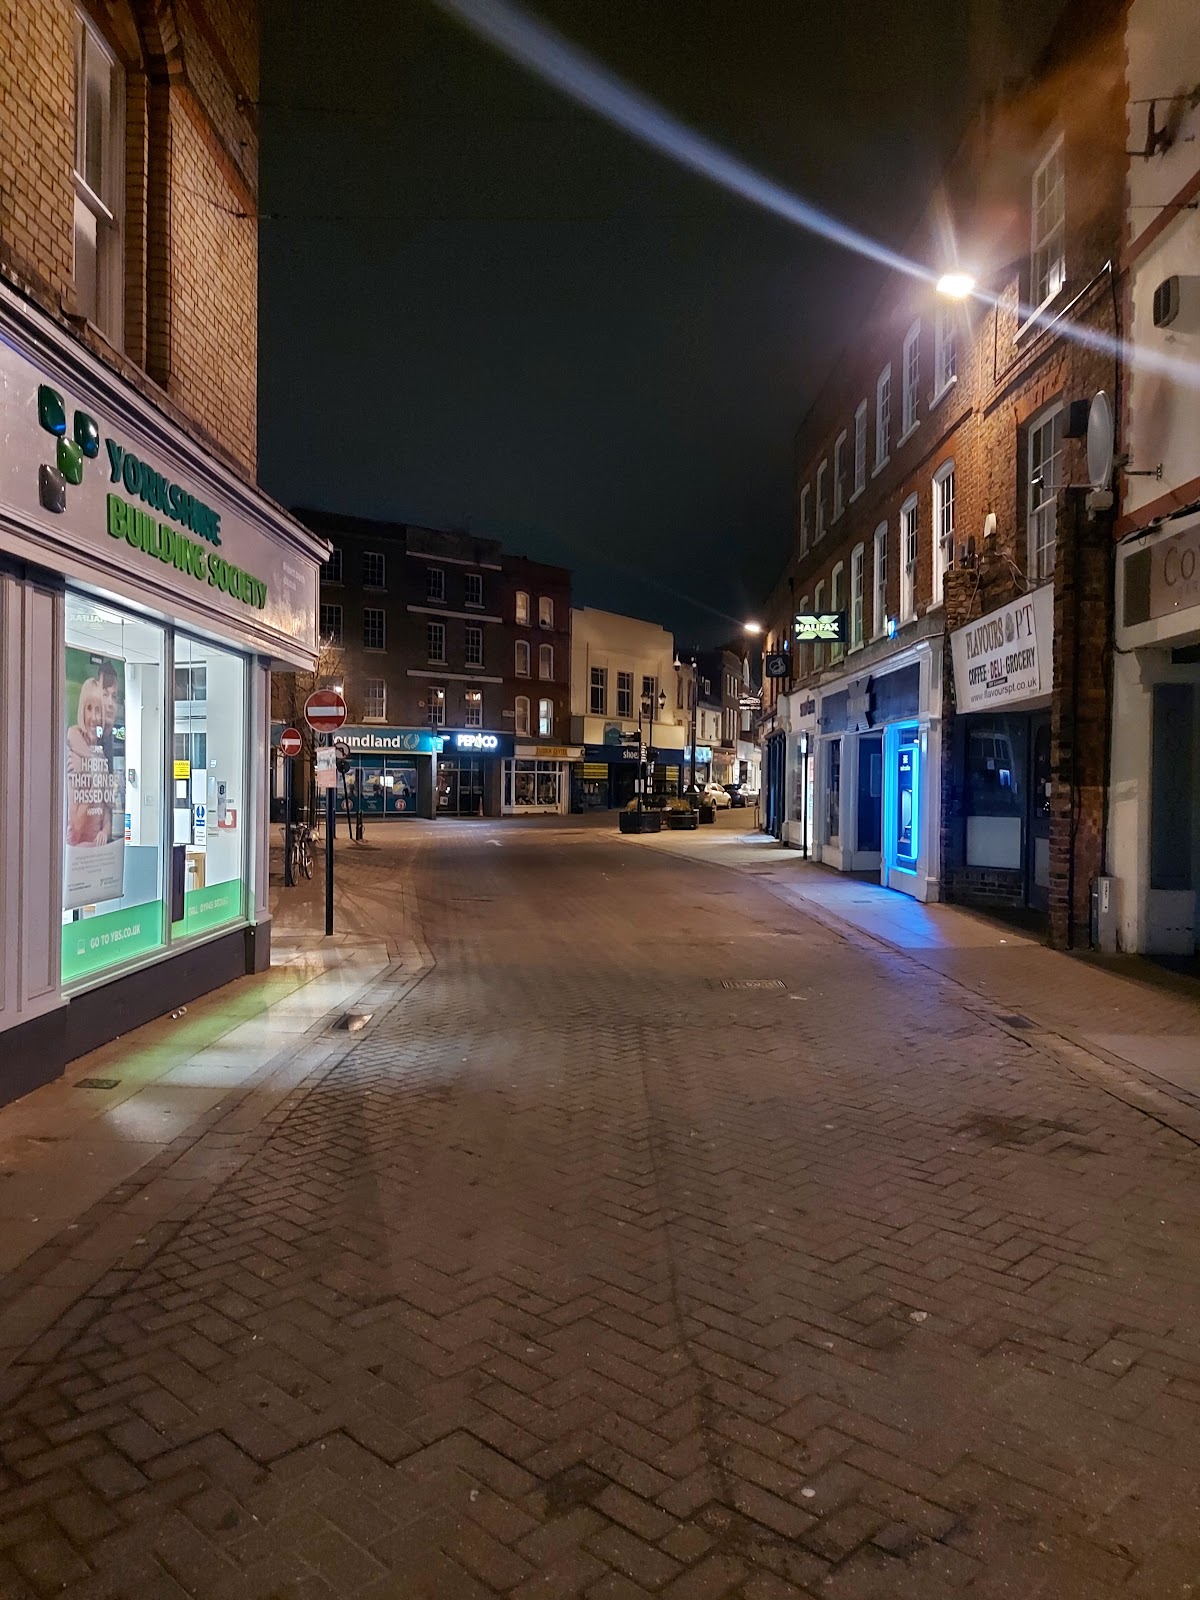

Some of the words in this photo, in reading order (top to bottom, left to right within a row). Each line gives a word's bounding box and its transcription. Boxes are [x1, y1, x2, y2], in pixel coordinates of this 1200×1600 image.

[105, 438, 222, 547] YORKSHIRE
[106, 492, 206, 580] BUILDING
[207, 552, 267, 610] SOCIETY
[1163, 546, 1200, 587] CO
[795, 622, 840, 632] HALIFAX
[965, 617, 1005, 660] FLAVOURS
[1014, 604, 1033, 640] PT
[968, 663, 988, 686] COFFEE
[990, 658, 1003, 680] DELI
[1005, 646, 1036, 675] GROCERY
[970, 677, 1038, 703] www.flavourspt.co.uk
[333, 733, 400, 748] oundland
[81, 758, 109, 772] HABITS
[70, 773, 91, 788] THAT
[92, 773, 108, 788] CAN
[108, 773, 120, 788] BE
[73, 789, 104, 804] PASSED
[104, 788, 115, 803] ON
[90, 936, 100, 949] GO
[100, 934, 110, 946] TO
[110, 923, 141, 943] YBS.CO.UK
